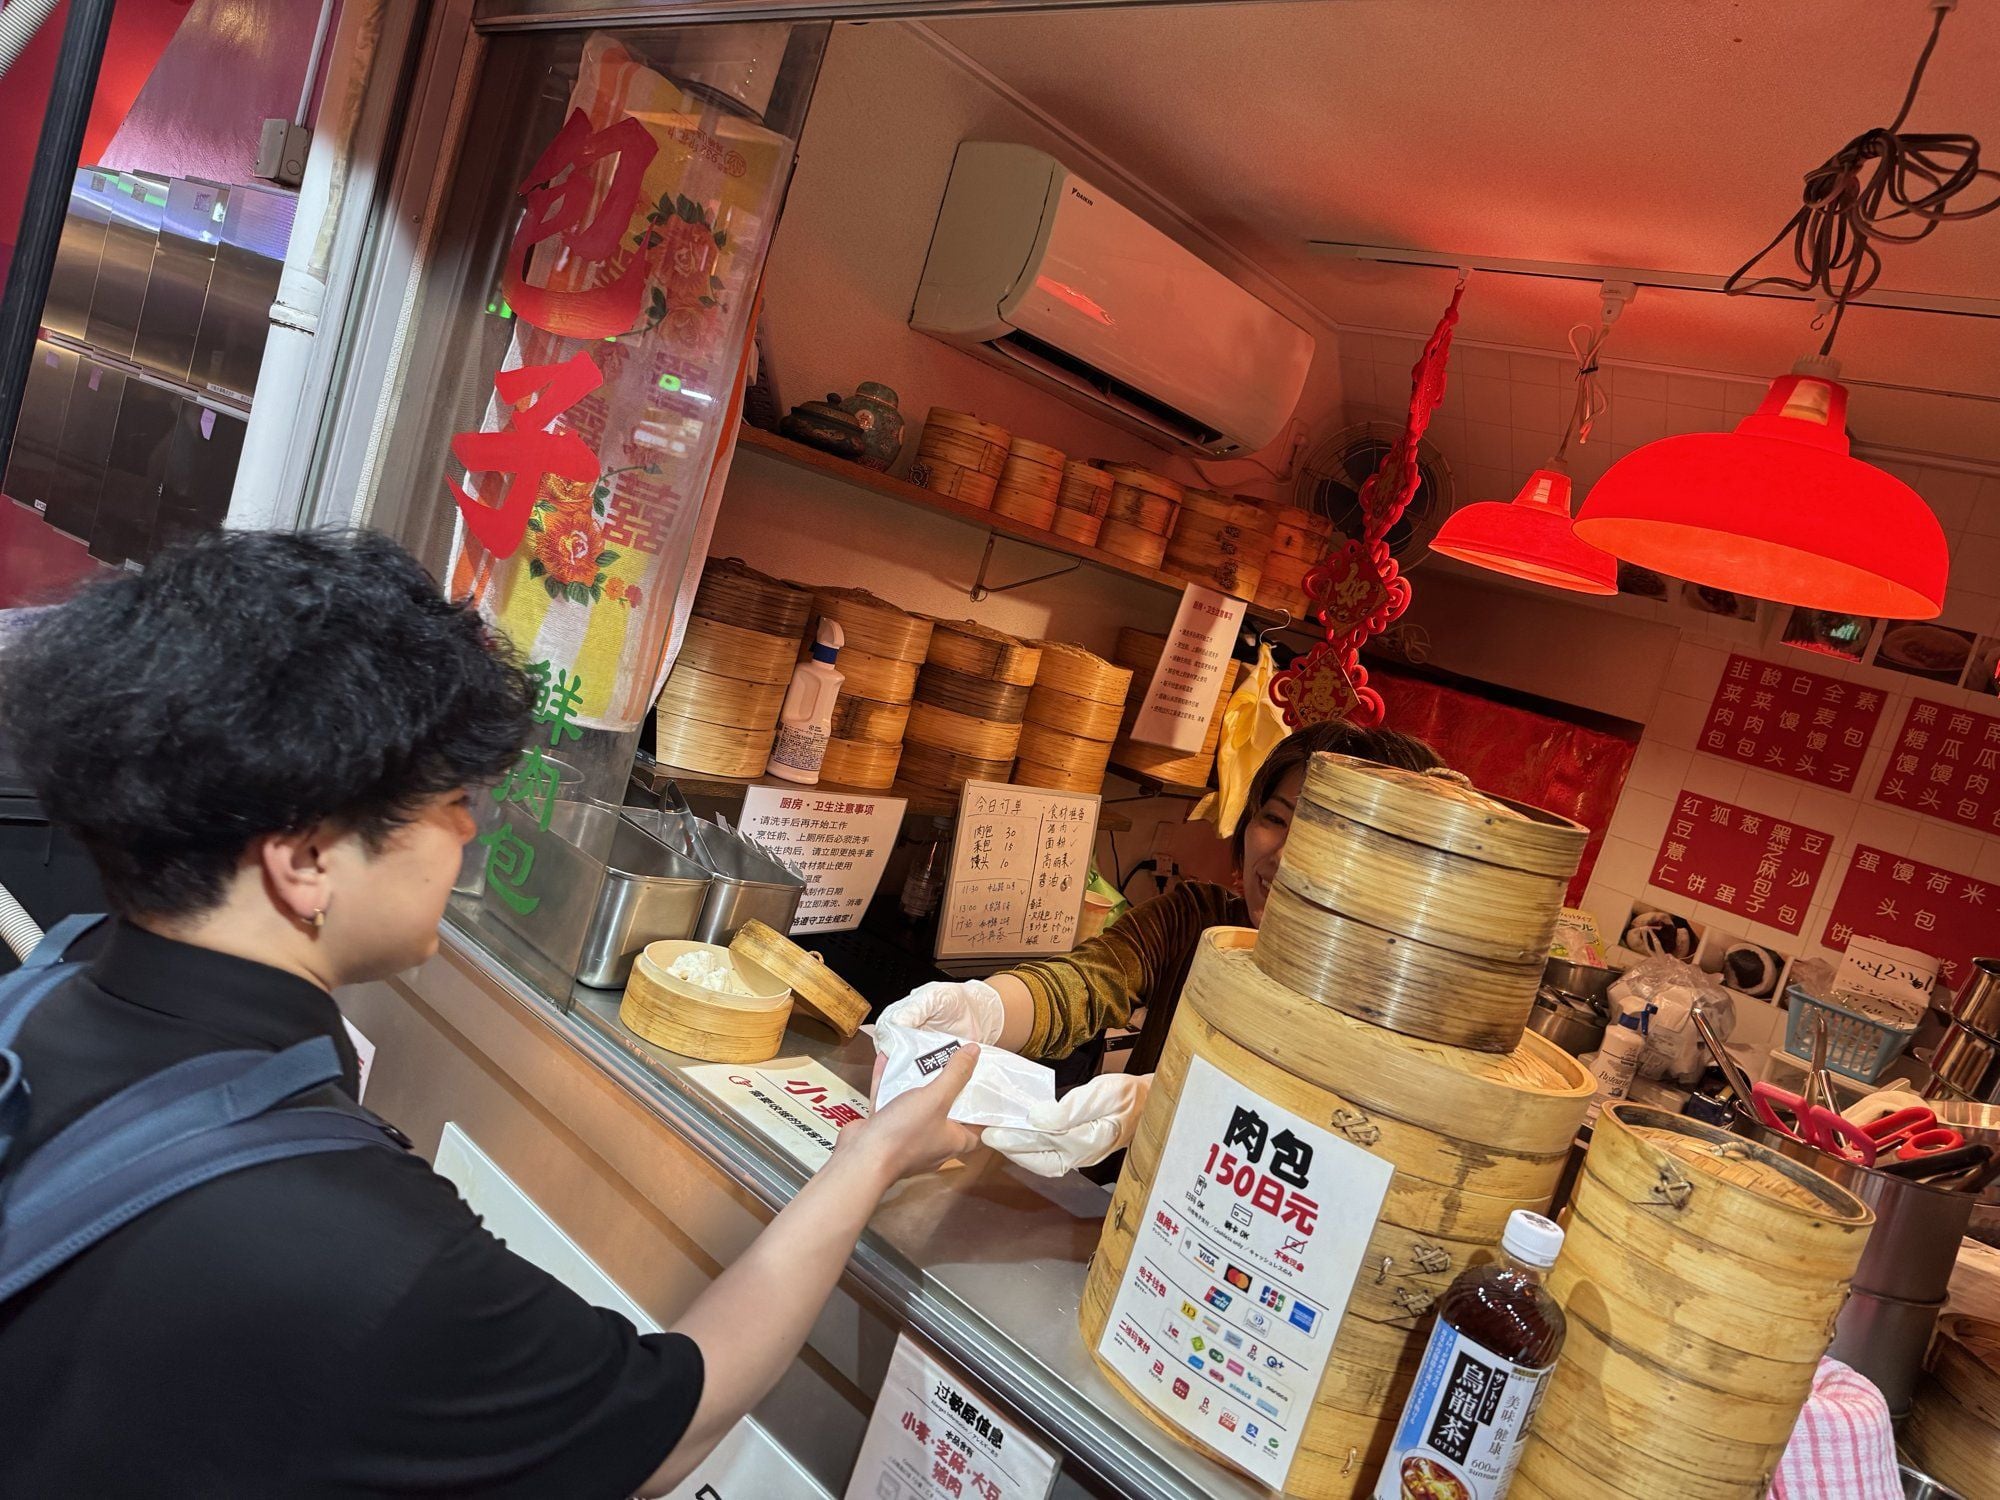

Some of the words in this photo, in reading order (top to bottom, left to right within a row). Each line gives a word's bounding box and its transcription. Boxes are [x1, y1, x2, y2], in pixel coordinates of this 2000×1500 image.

[445, 107, 658, 560] 包子
[1707, 660, 1752, 749] 韭菜肉包
[1736, 667, 1782, 758] 酸菜肉包
[1764, 676, 1812, 767] 白馒头
[1796, 683, 1846, 776] 全麦馒头
[1828, 691, 1879, 784] 素包子
[1884, 704, 1938, 800] 黑糖馒头
[1918, 713, 1974, 810] 南瓜馒头
[759, 815, 848, 830] 请洗手后再开始工作
[1005, 827, 1016, 838] 30
[1777, 833, 1826, 925] 豆沙包
[1204, 1143, 1319, 1236] 150日元
[1223, 1105, 1313, 1189] 肉包
[1156, 1210, 1180, 1236] 信用卡
[1199, 1250, 1215, 1267] VISA
[934, 1380, 1004, 1449] 过敏原信息
[1484, 1373, 1504, 1420] サントリー
[1434, 1439, 1461, 1457] OTPP
